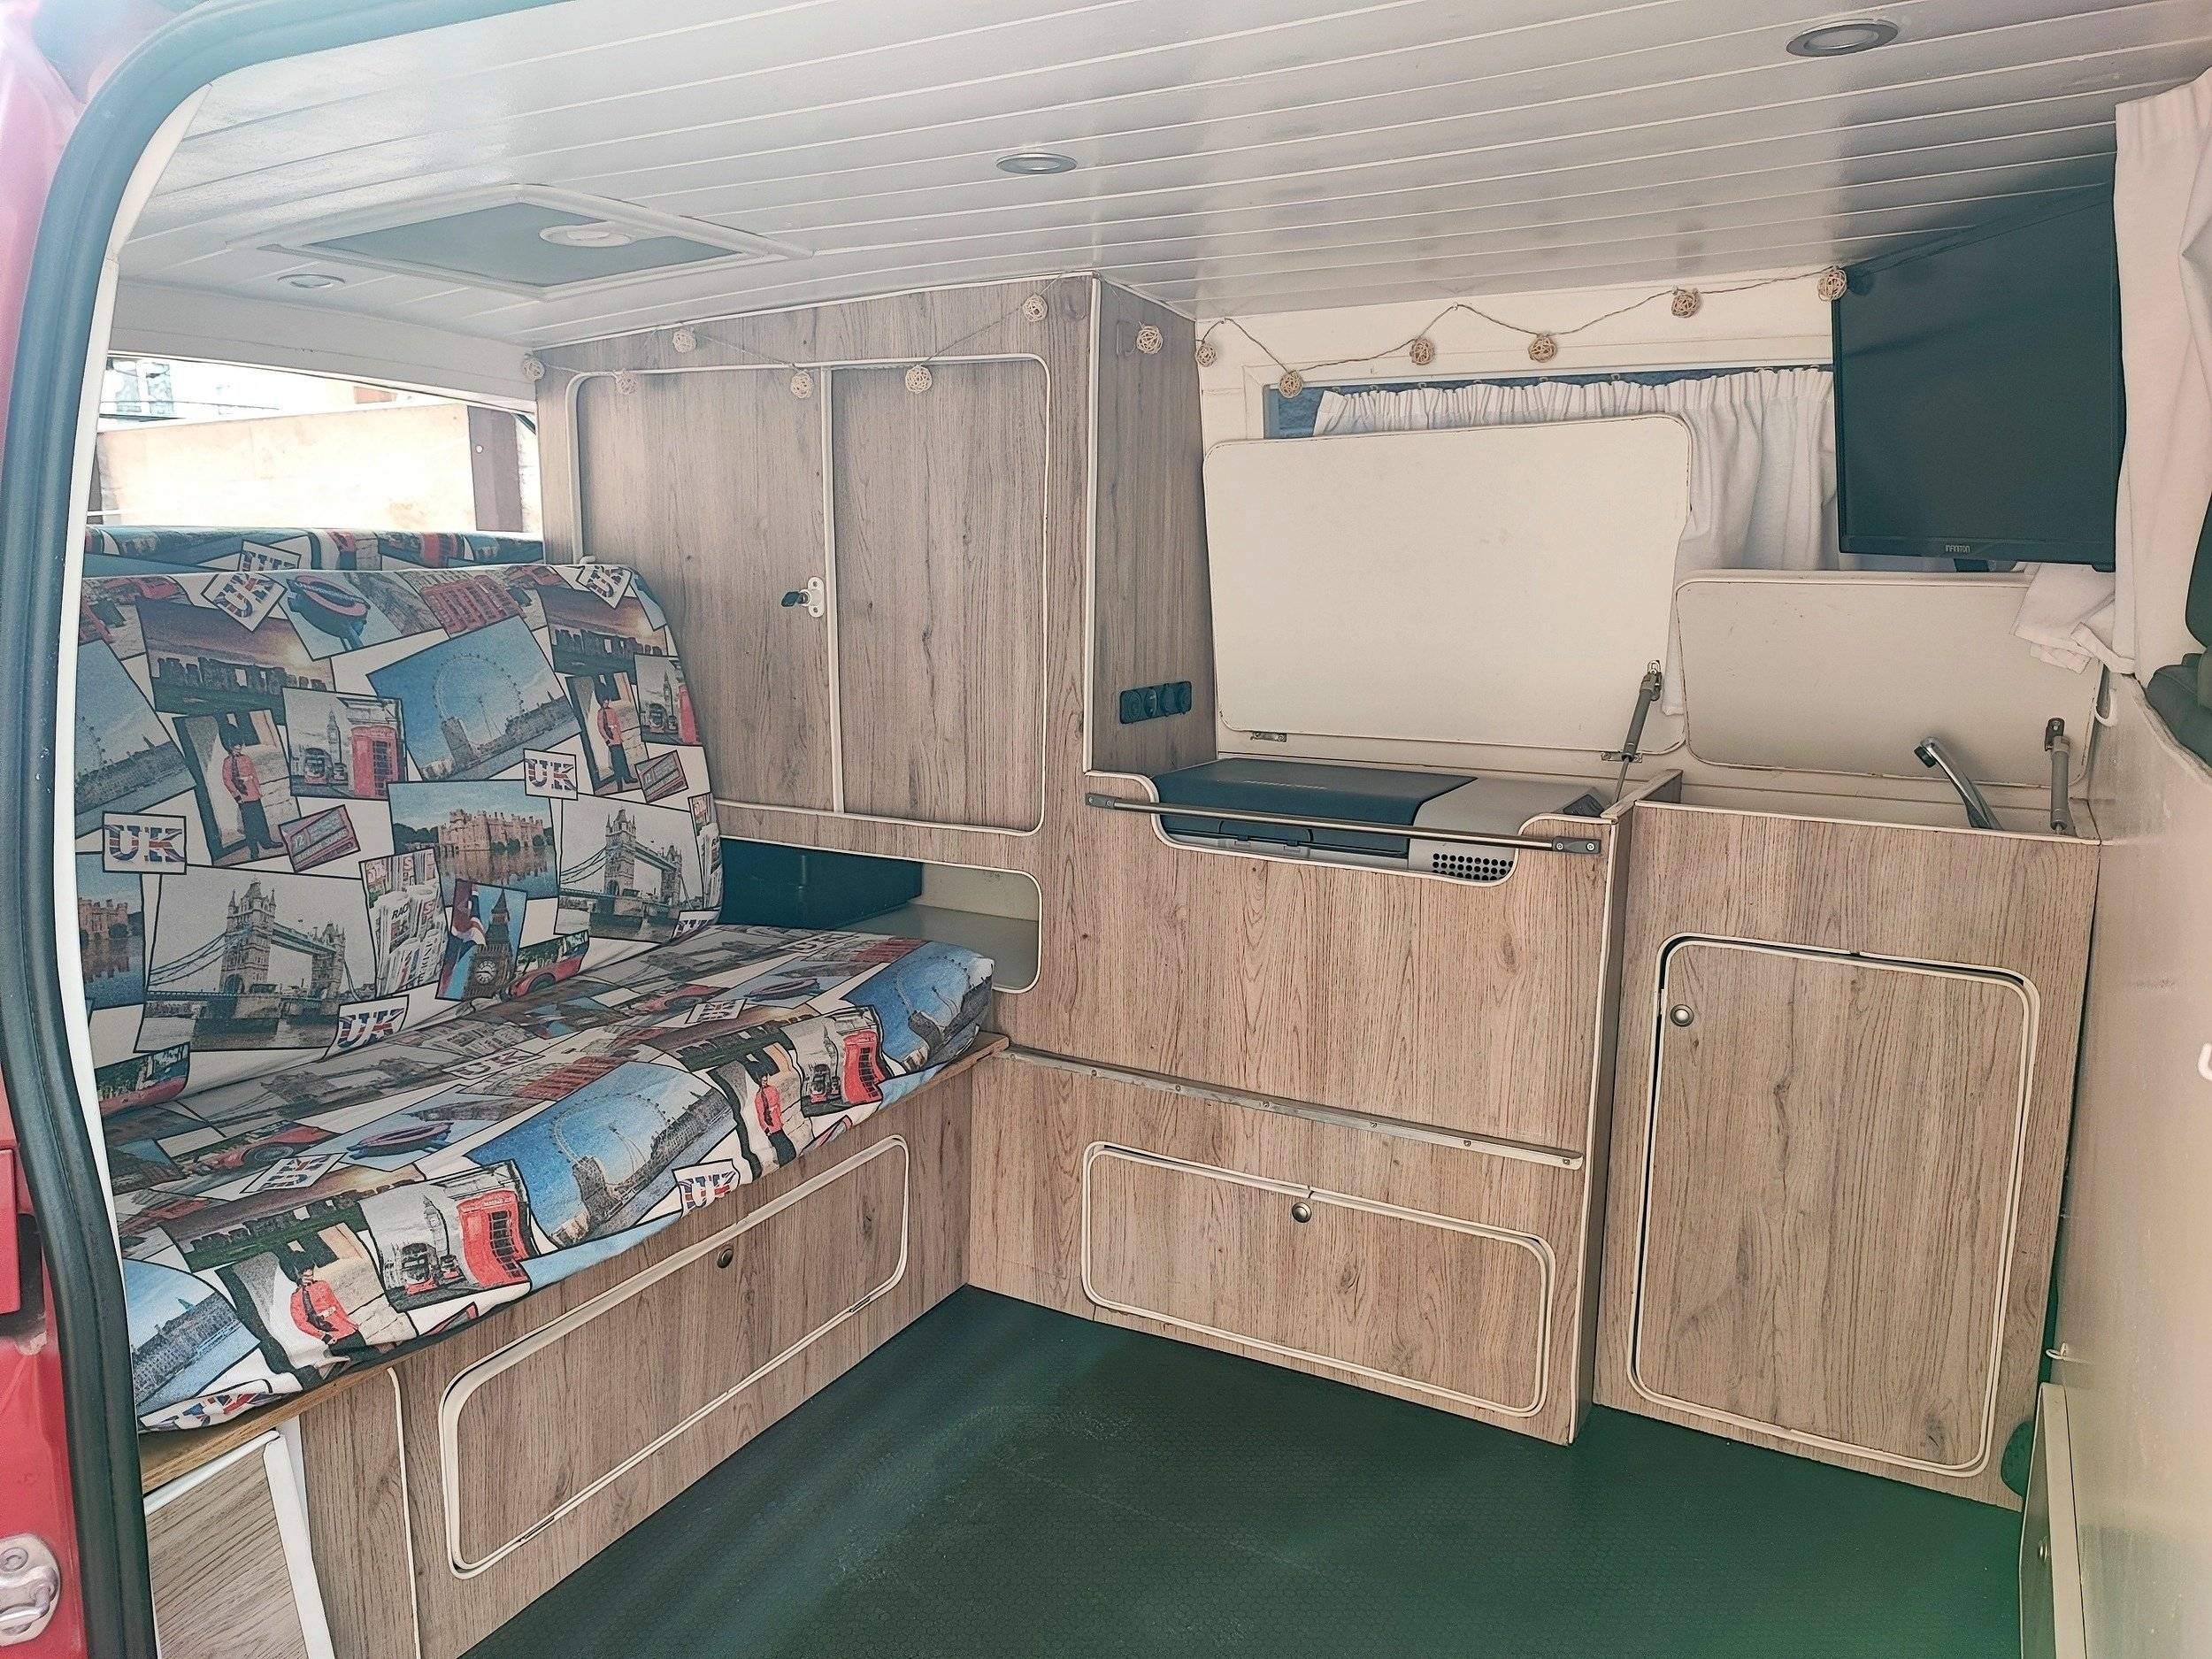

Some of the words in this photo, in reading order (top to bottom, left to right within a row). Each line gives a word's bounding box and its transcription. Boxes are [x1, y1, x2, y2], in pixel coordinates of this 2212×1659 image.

[213, 572, 274, 618] UK
[525, 757, 577, 790] UK
[104, 825, 186, 863] UK
[338, 1007, 405, 1048] UK
